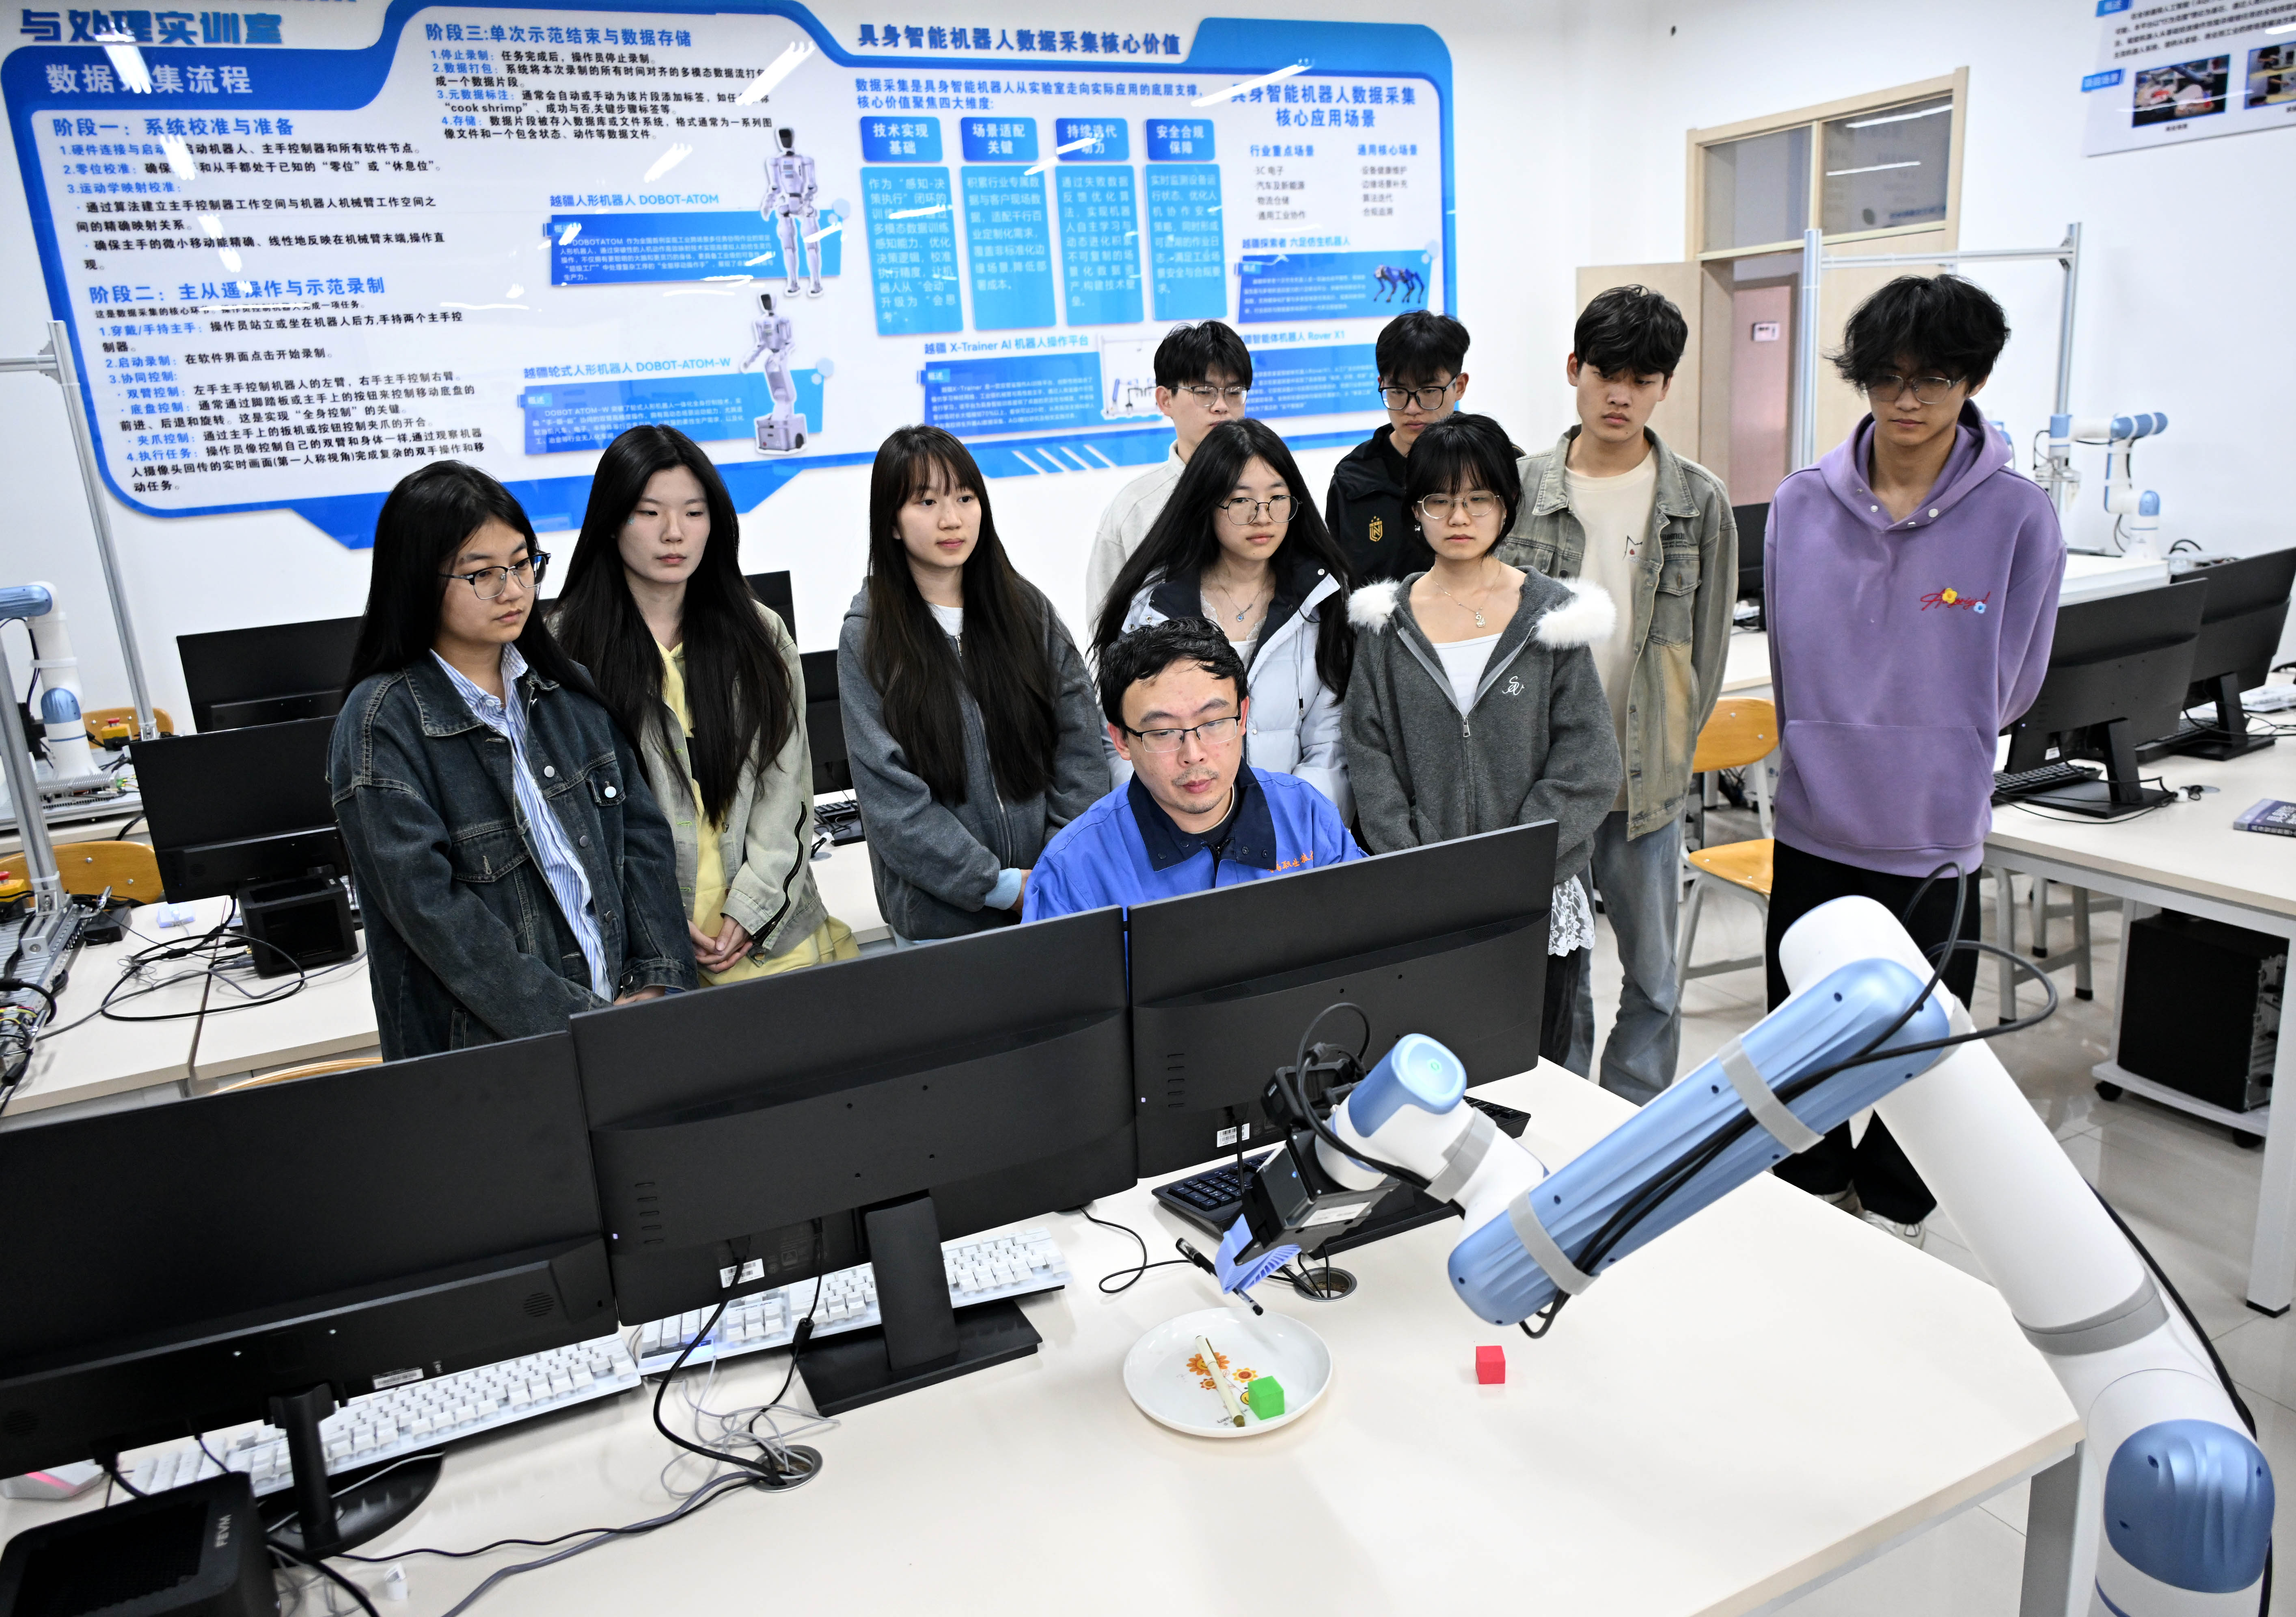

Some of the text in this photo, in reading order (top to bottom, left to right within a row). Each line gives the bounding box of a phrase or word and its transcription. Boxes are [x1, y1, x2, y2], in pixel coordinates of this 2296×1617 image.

[20, 9, 283, 45] 与处理实训室
[858, 24, 1181, 55] 具身智能机器人数据采集核心价值
[45, 65, 253, 94] 数据集流程
[436, 76, 524, 88] 成一个数据片段。
[1231, 84, 1416, 105] 具身智能机器人数据采集
[1276, 108, 1376, 127] 核心应用场景
[873, 123, 929, 138] 技术实现
[973, 123, 1025, 138] 场景适配
[1156, 125, 1204, 138] 安全合规
[889, 140, 916, 155] 基础
[988, 140, 1014, 154] 关键
[1170, 141, 1193, 154] 保障
[1250, 144, 1315, 157] 行业重点场景
[1357, 144, 1418, 157] 通用核心场景
[549, 194, 719, 207] 越疆人形机器人 DOBOT-ATOM
[84, 259, 105, 270] 观。
[925, 335, 1089, 355] 越疆 X-Trainer AI 机器人操作平台
[1241, 332, 1306, 344] 疆智能体机器人
[102, 341, 136, 353] 制器。
[524, 358, 731, 379] 越疆轮式人形机器人 DOBOT-ATOM-W
[134, 480, 180, 493] 动任务。
